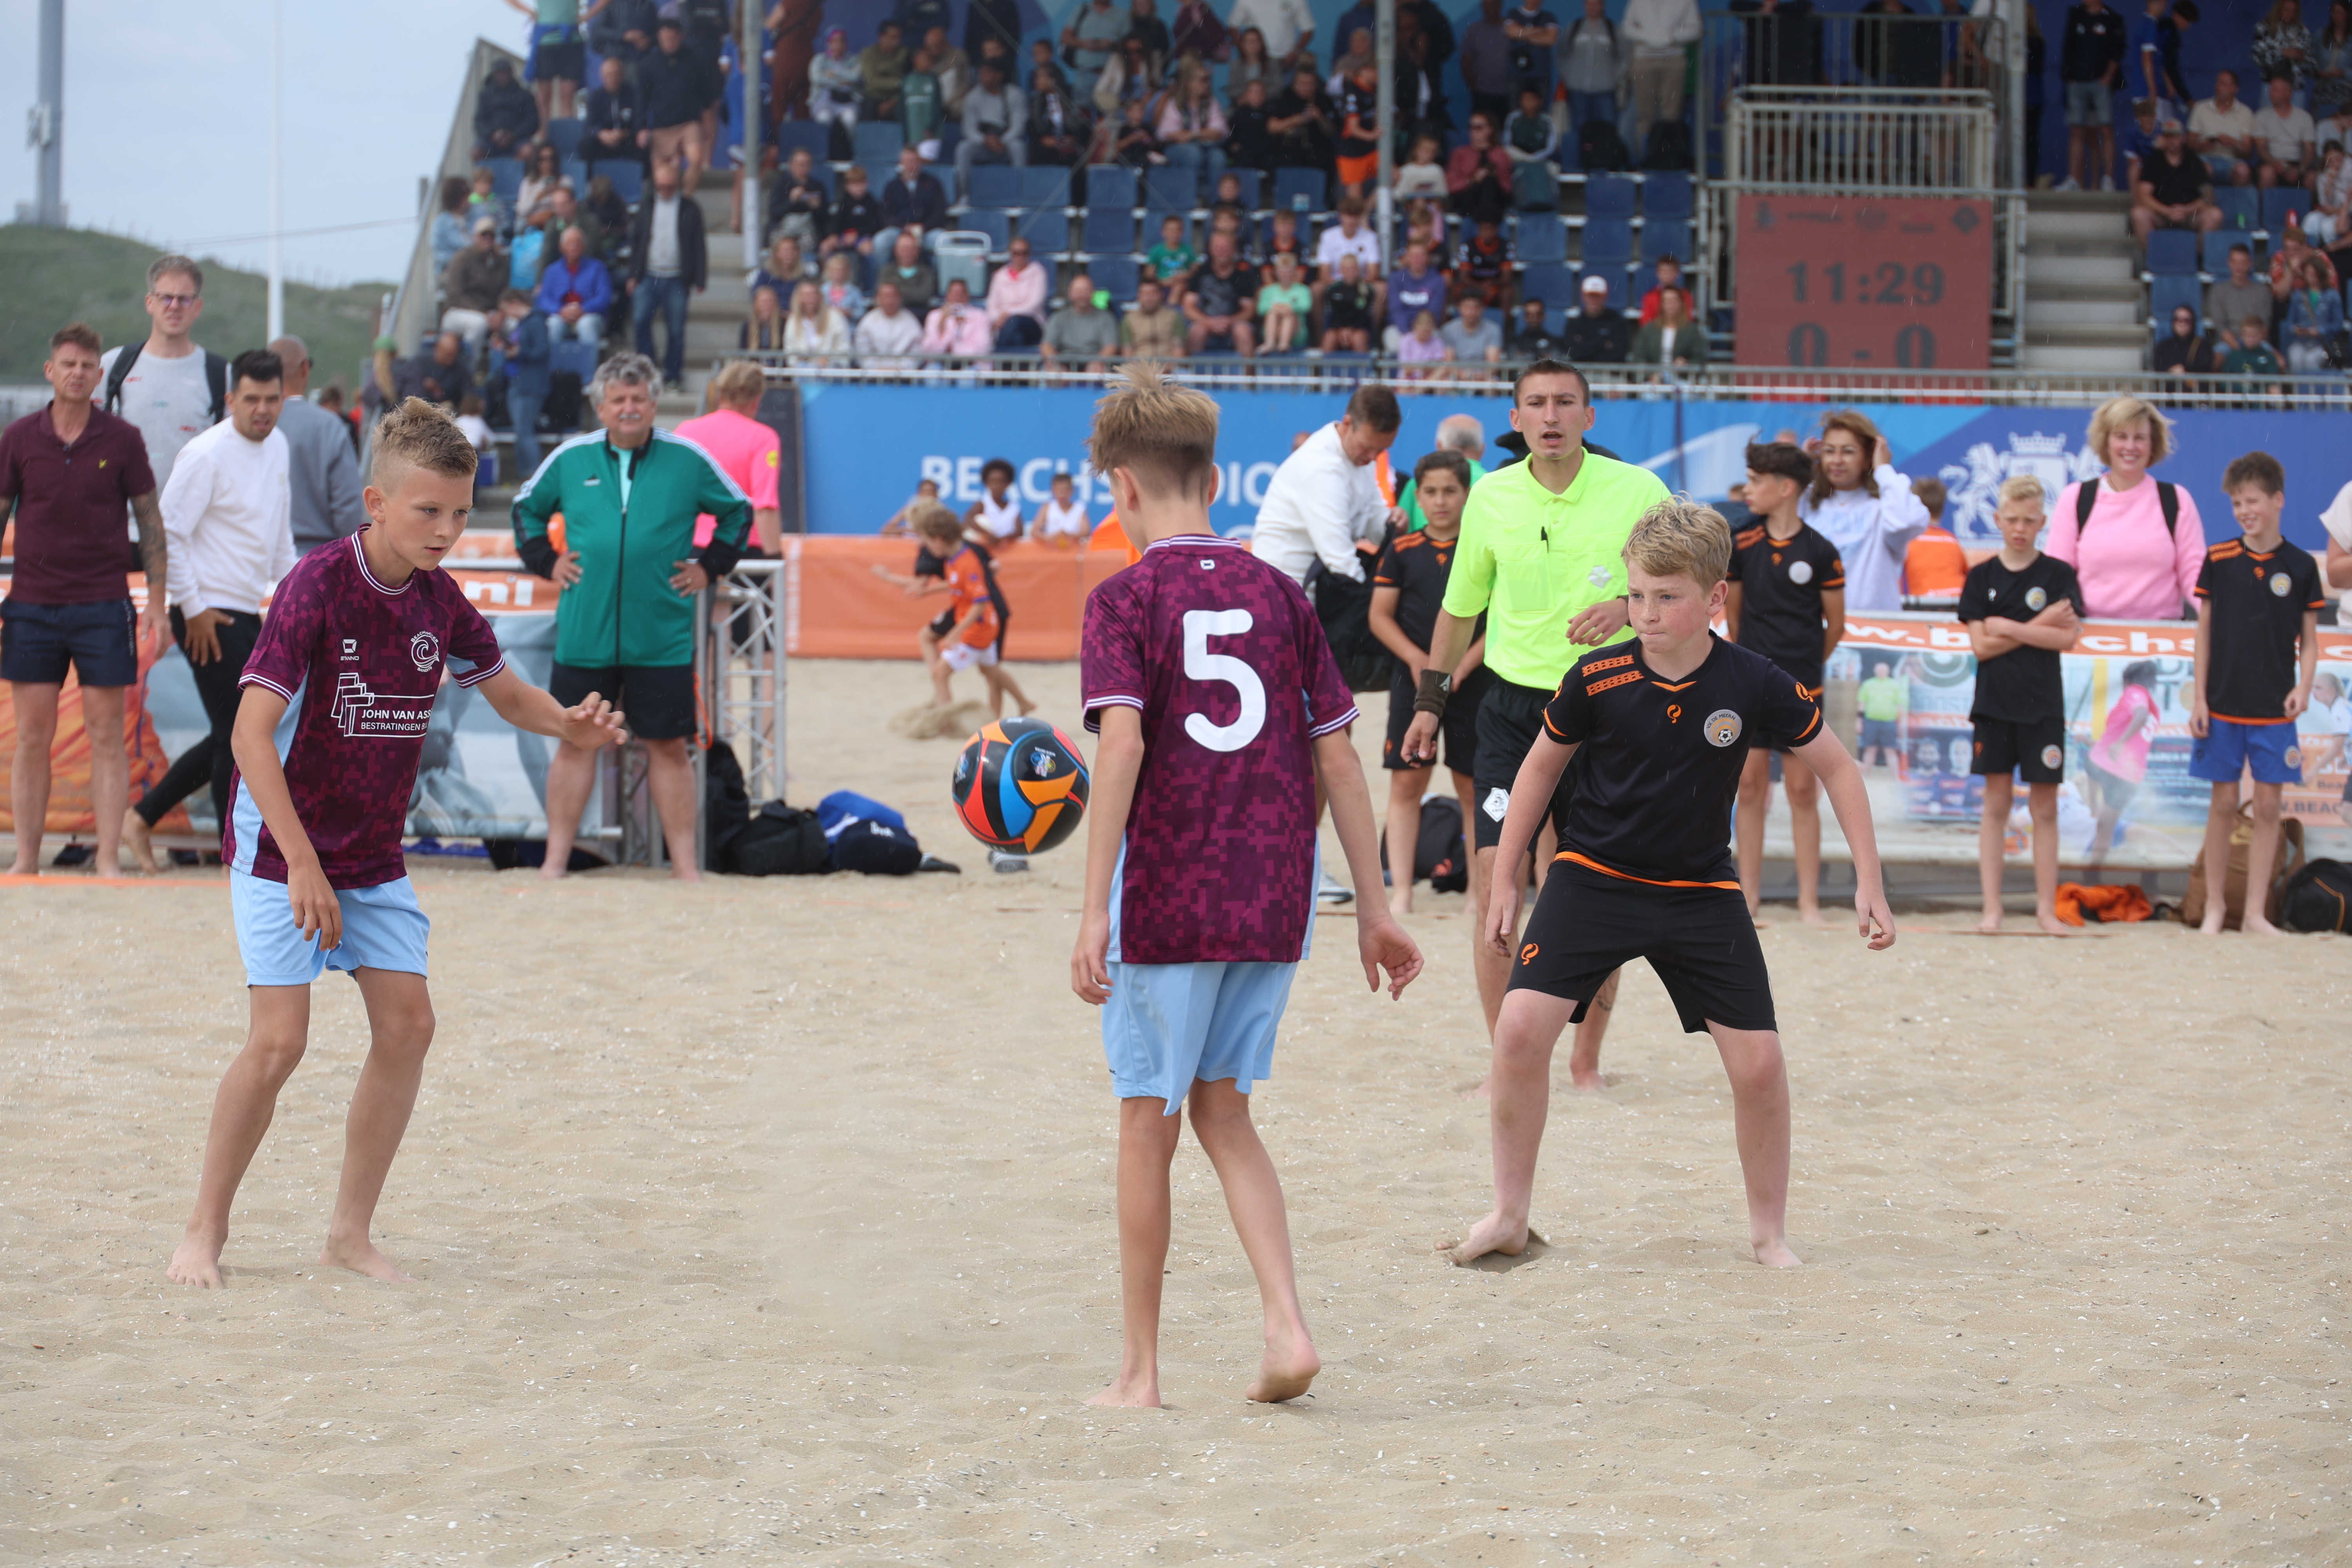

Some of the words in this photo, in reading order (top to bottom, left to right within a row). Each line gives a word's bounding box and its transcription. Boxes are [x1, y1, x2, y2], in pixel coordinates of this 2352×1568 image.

[1787, 261, 1945, 306] 11:29
[1788, 321, 1828, 367] 0
[1895, 323, 1936, 368] 0
[1183, 609, 1267, 752] 5
[361, 710, 389, 719] JOHN
[392, 710, 415, 720] VAN
[361, 722, 421, 731] BESTRATINGEN
